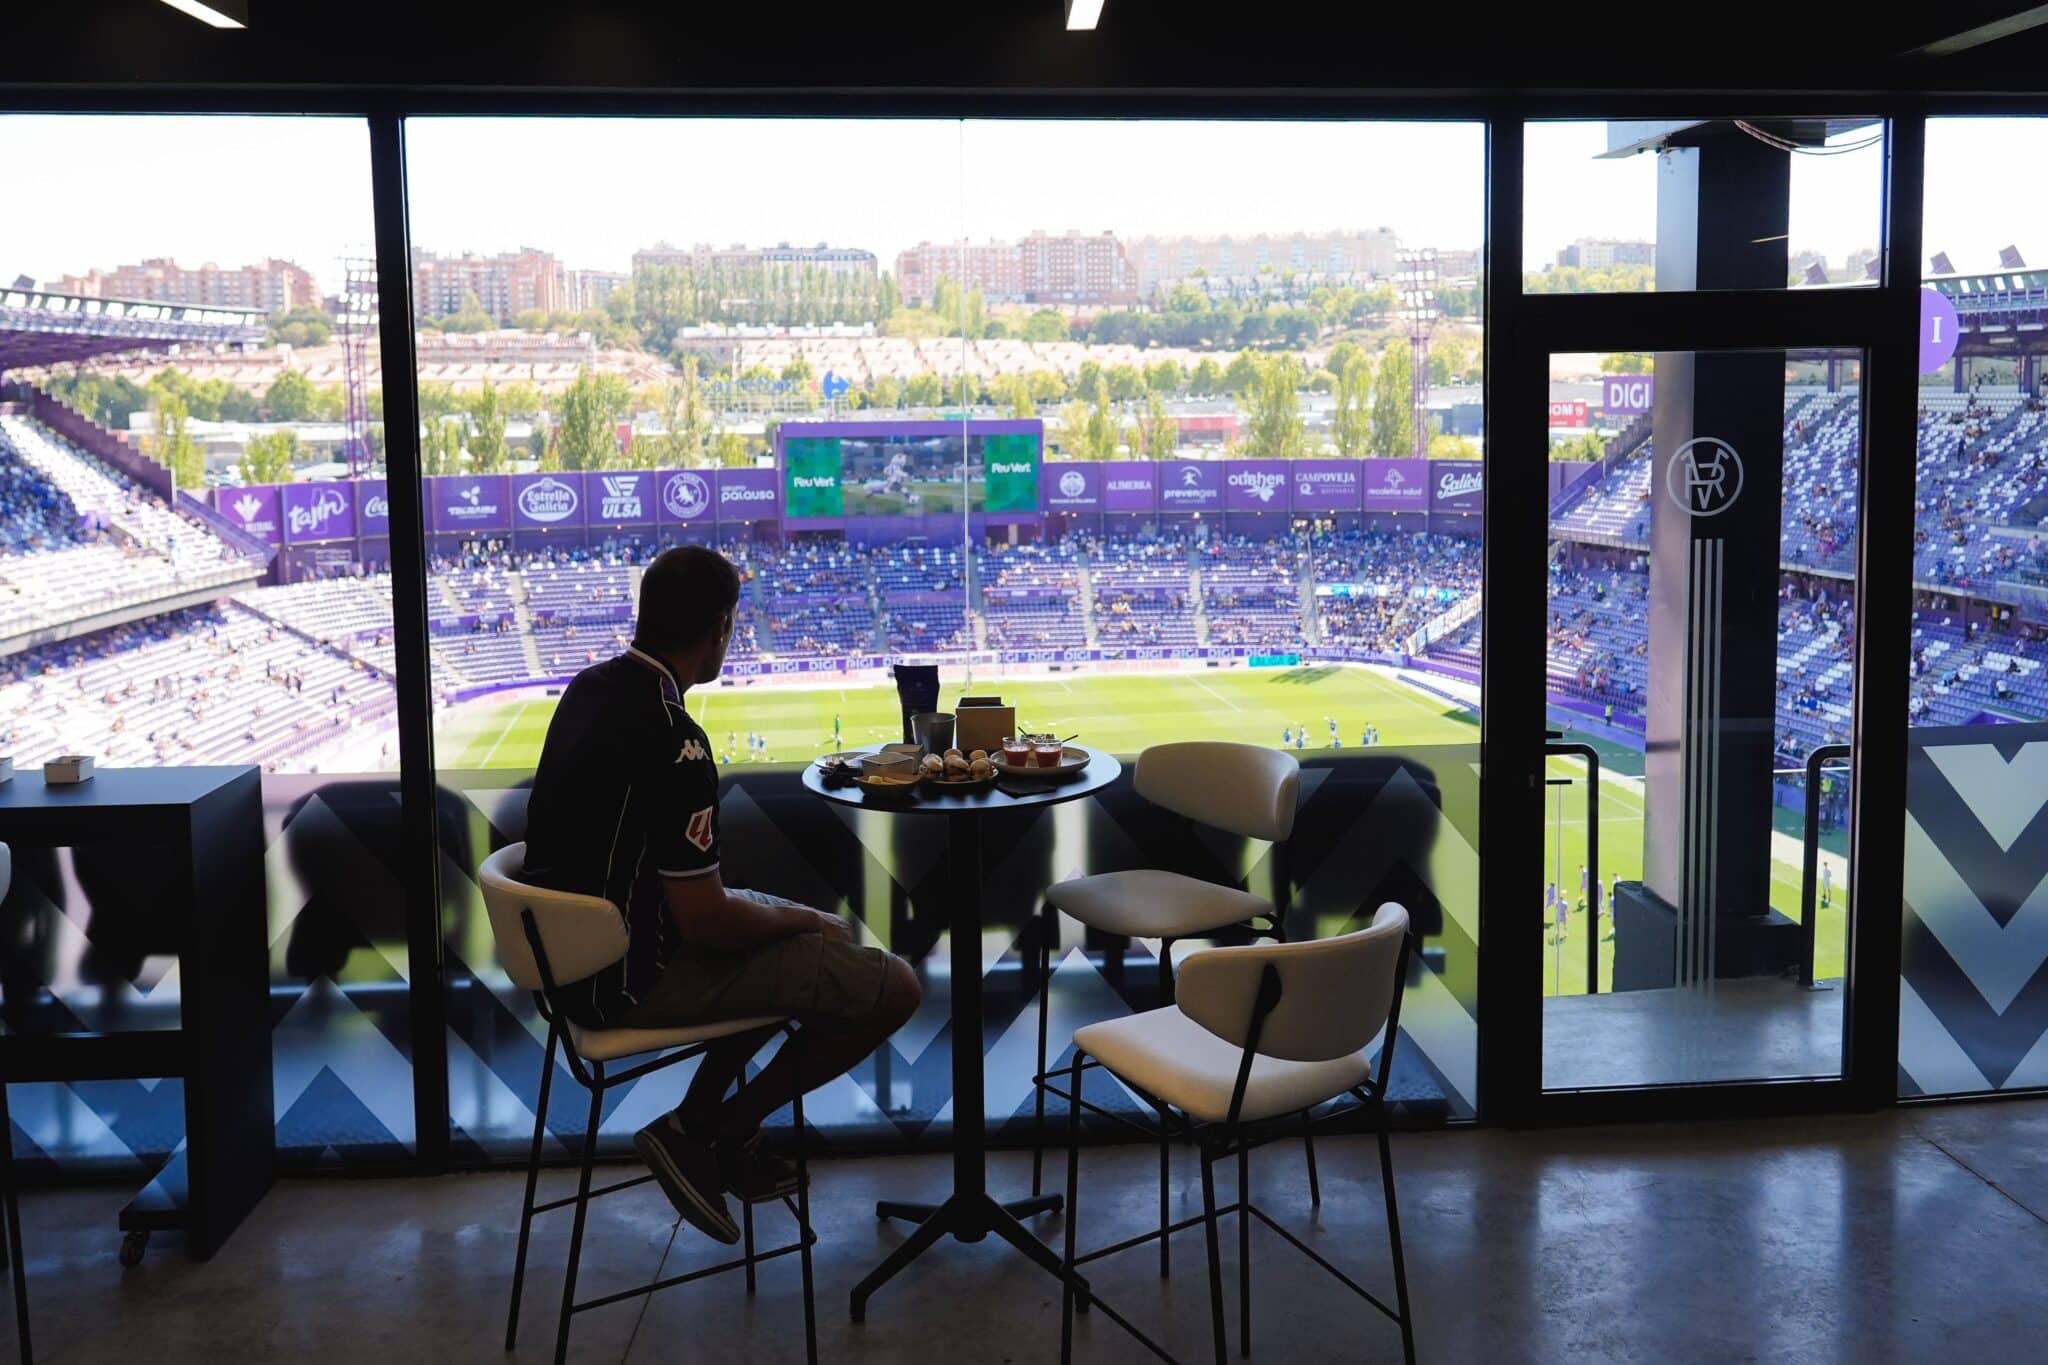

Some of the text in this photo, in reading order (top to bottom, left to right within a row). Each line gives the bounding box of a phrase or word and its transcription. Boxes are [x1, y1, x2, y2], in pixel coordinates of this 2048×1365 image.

[1611, 383, 1650, 409] DIGI
[991, 462, 1031, 474] Feu Vert
[794, 476, 834, 488] Feu Vert
[602, 503, 642, 519] ULSA
[733, 663, 761, 676] DIGI
[771, 661, 799, 674] DIGI
[809, 659, 837, 671] DIGI
[846, 657, 874, 669] DIGI
[1028, 651, 1055, 662] DIGI
[1064, 650, 1091, 661] DIGI
[1208, 648, 1234, 659] DIGI
